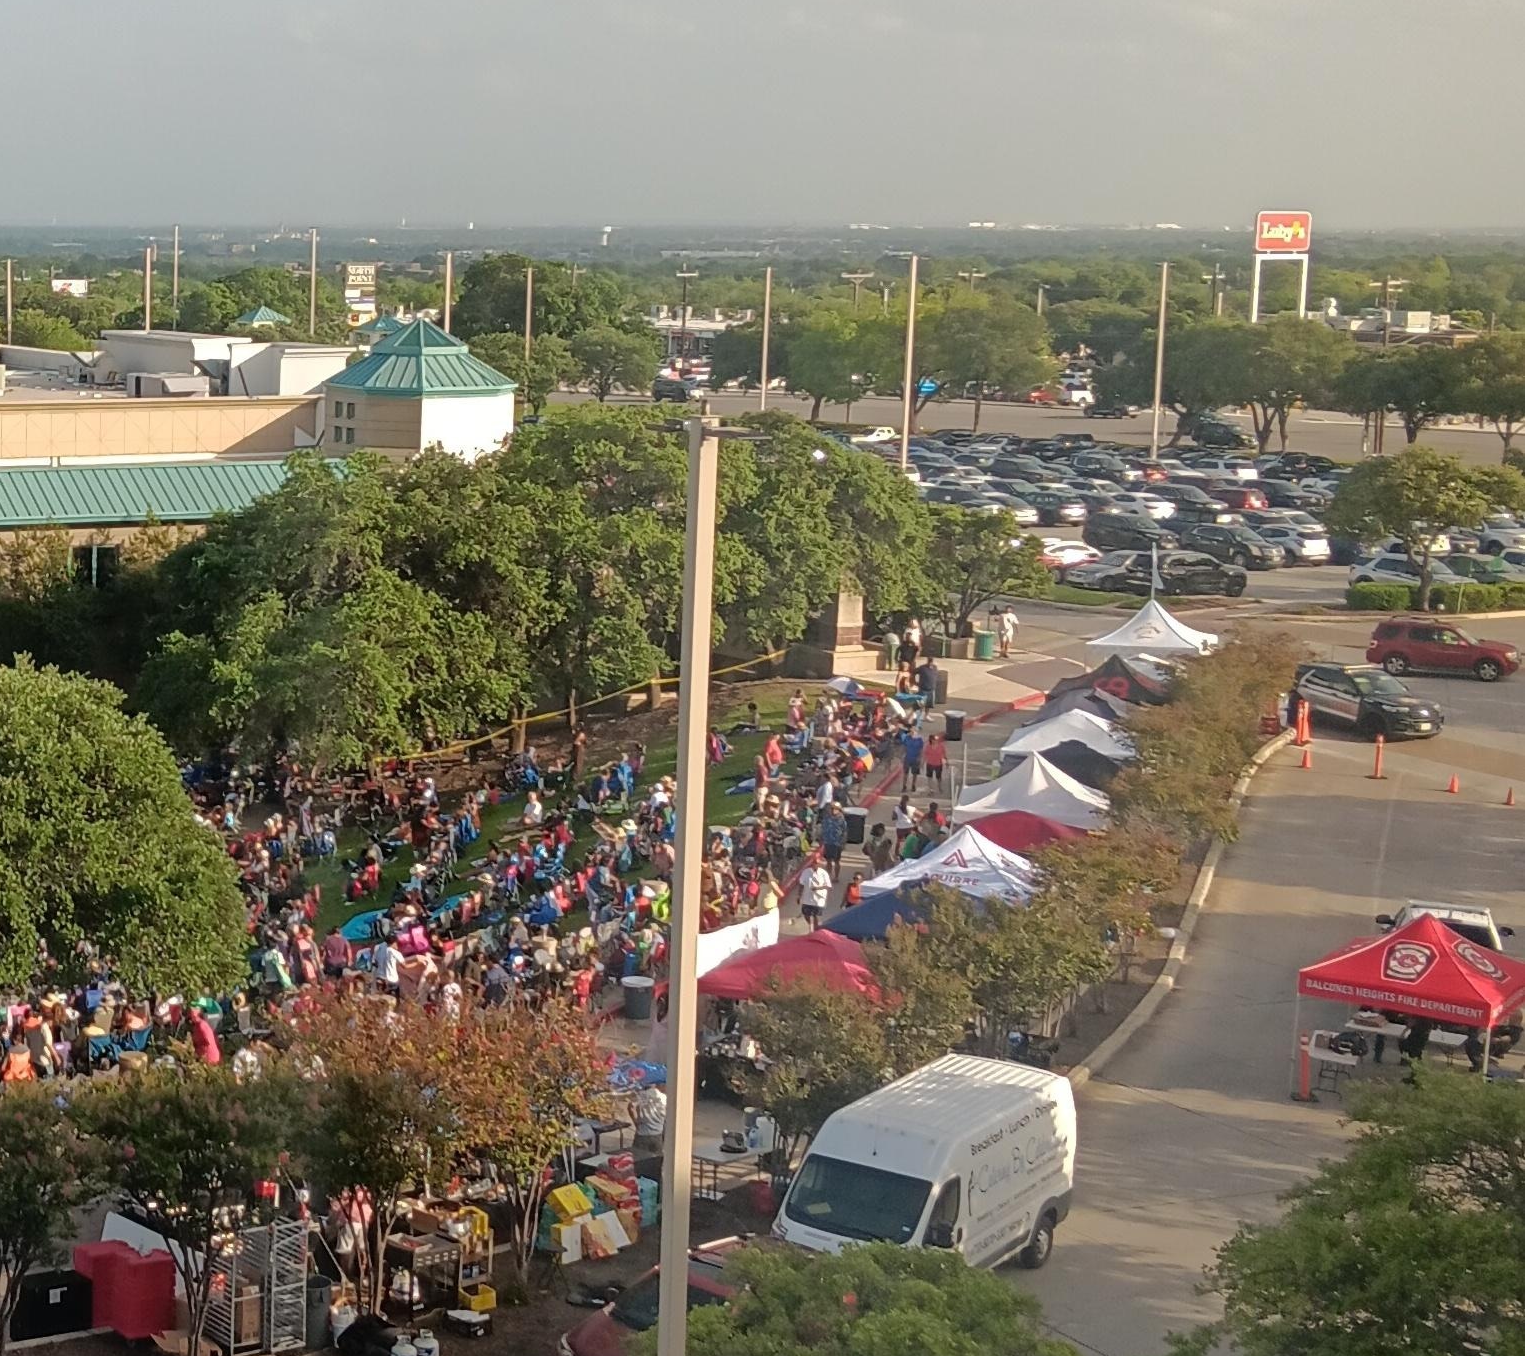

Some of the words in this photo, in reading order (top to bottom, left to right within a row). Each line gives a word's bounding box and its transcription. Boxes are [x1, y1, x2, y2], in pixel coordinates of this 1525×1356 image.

[1261, 221, 1305, 242] Luby's
[1306, 979, 1354, 995] BALCONES
[1356, 986, 1396, 1002] HEIGHTS
[1397, 994, 1418, 1007] FIRE
[1420, 998, 1483, 1018] DEPARTMENT
